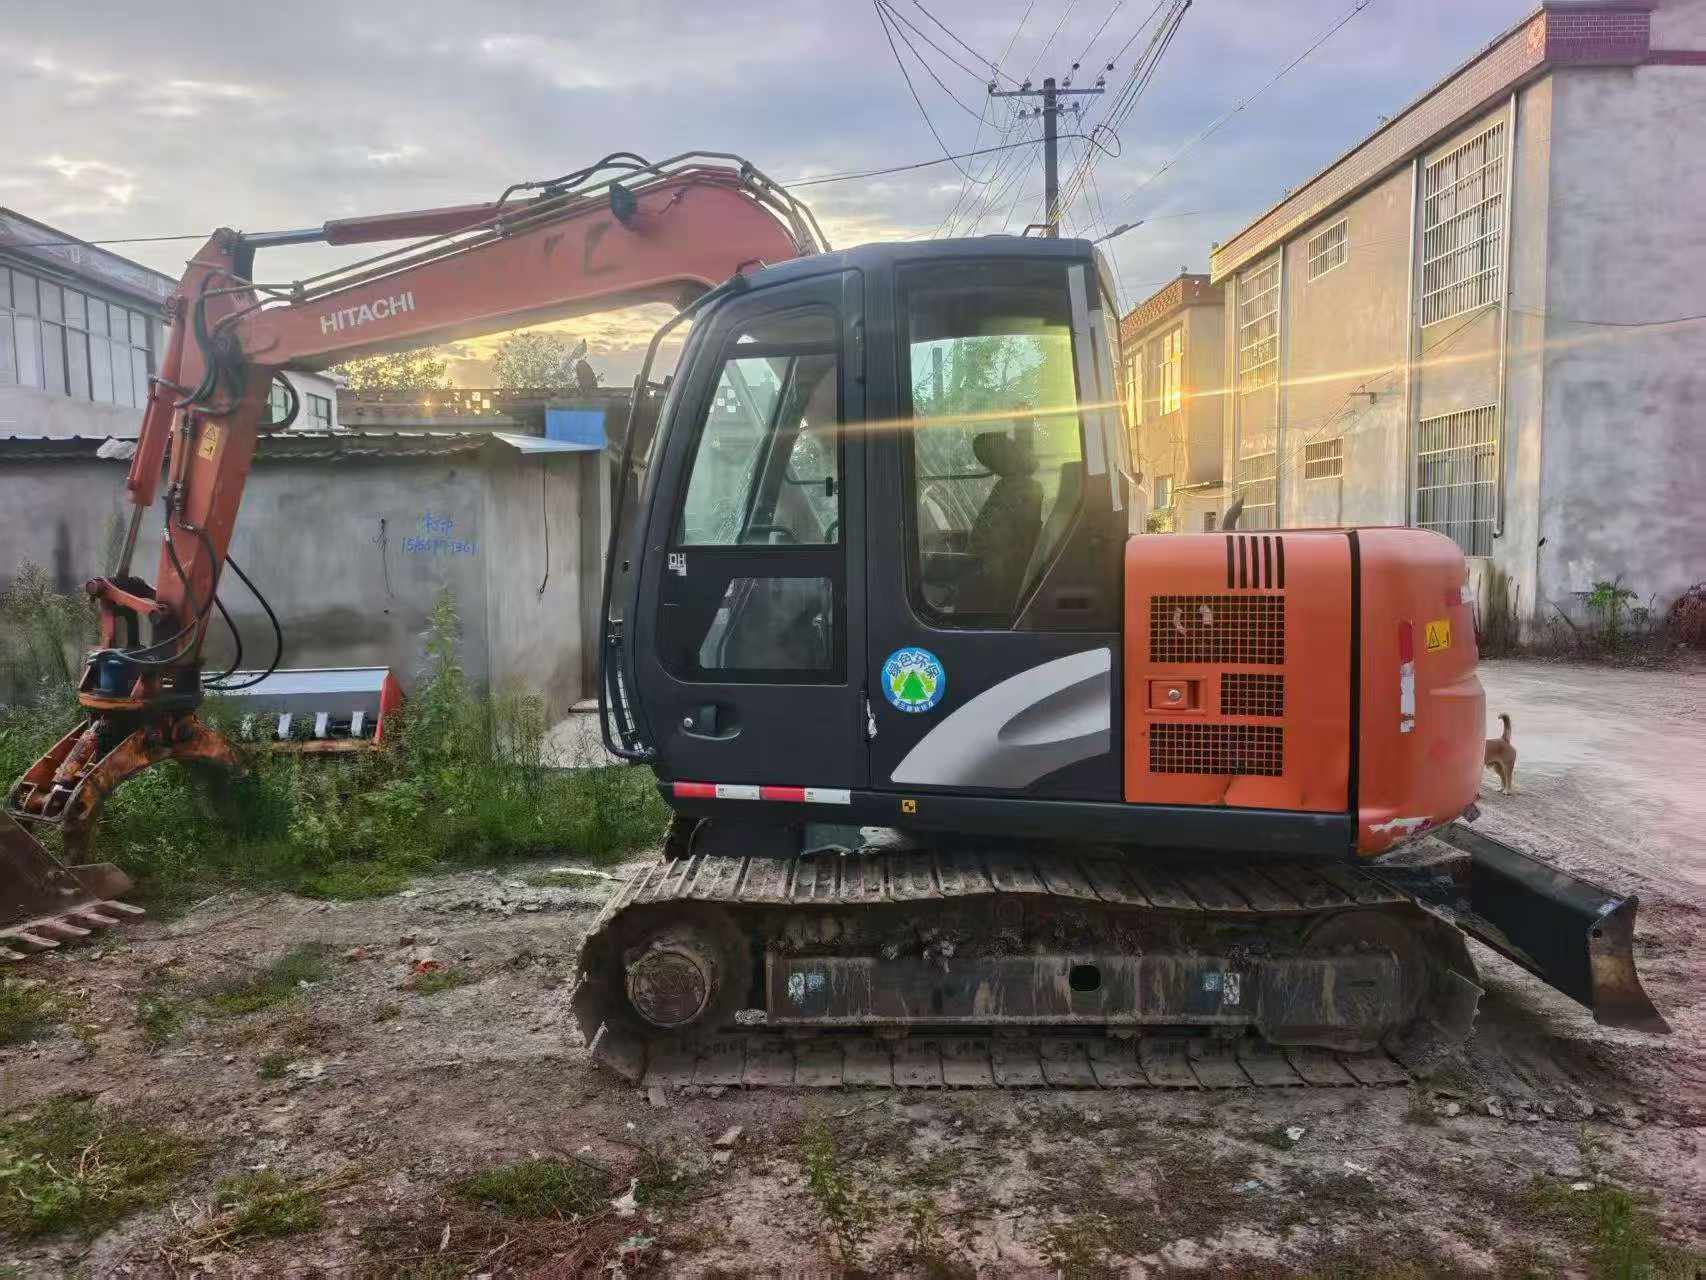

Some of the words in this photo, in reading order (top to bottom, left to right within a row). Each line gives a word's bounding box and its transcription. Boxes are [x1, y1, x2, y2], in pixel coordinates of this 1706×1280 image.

[320, 291, 415, 335] HITACHI
[887, 651, 940, 679] 绿色环保
